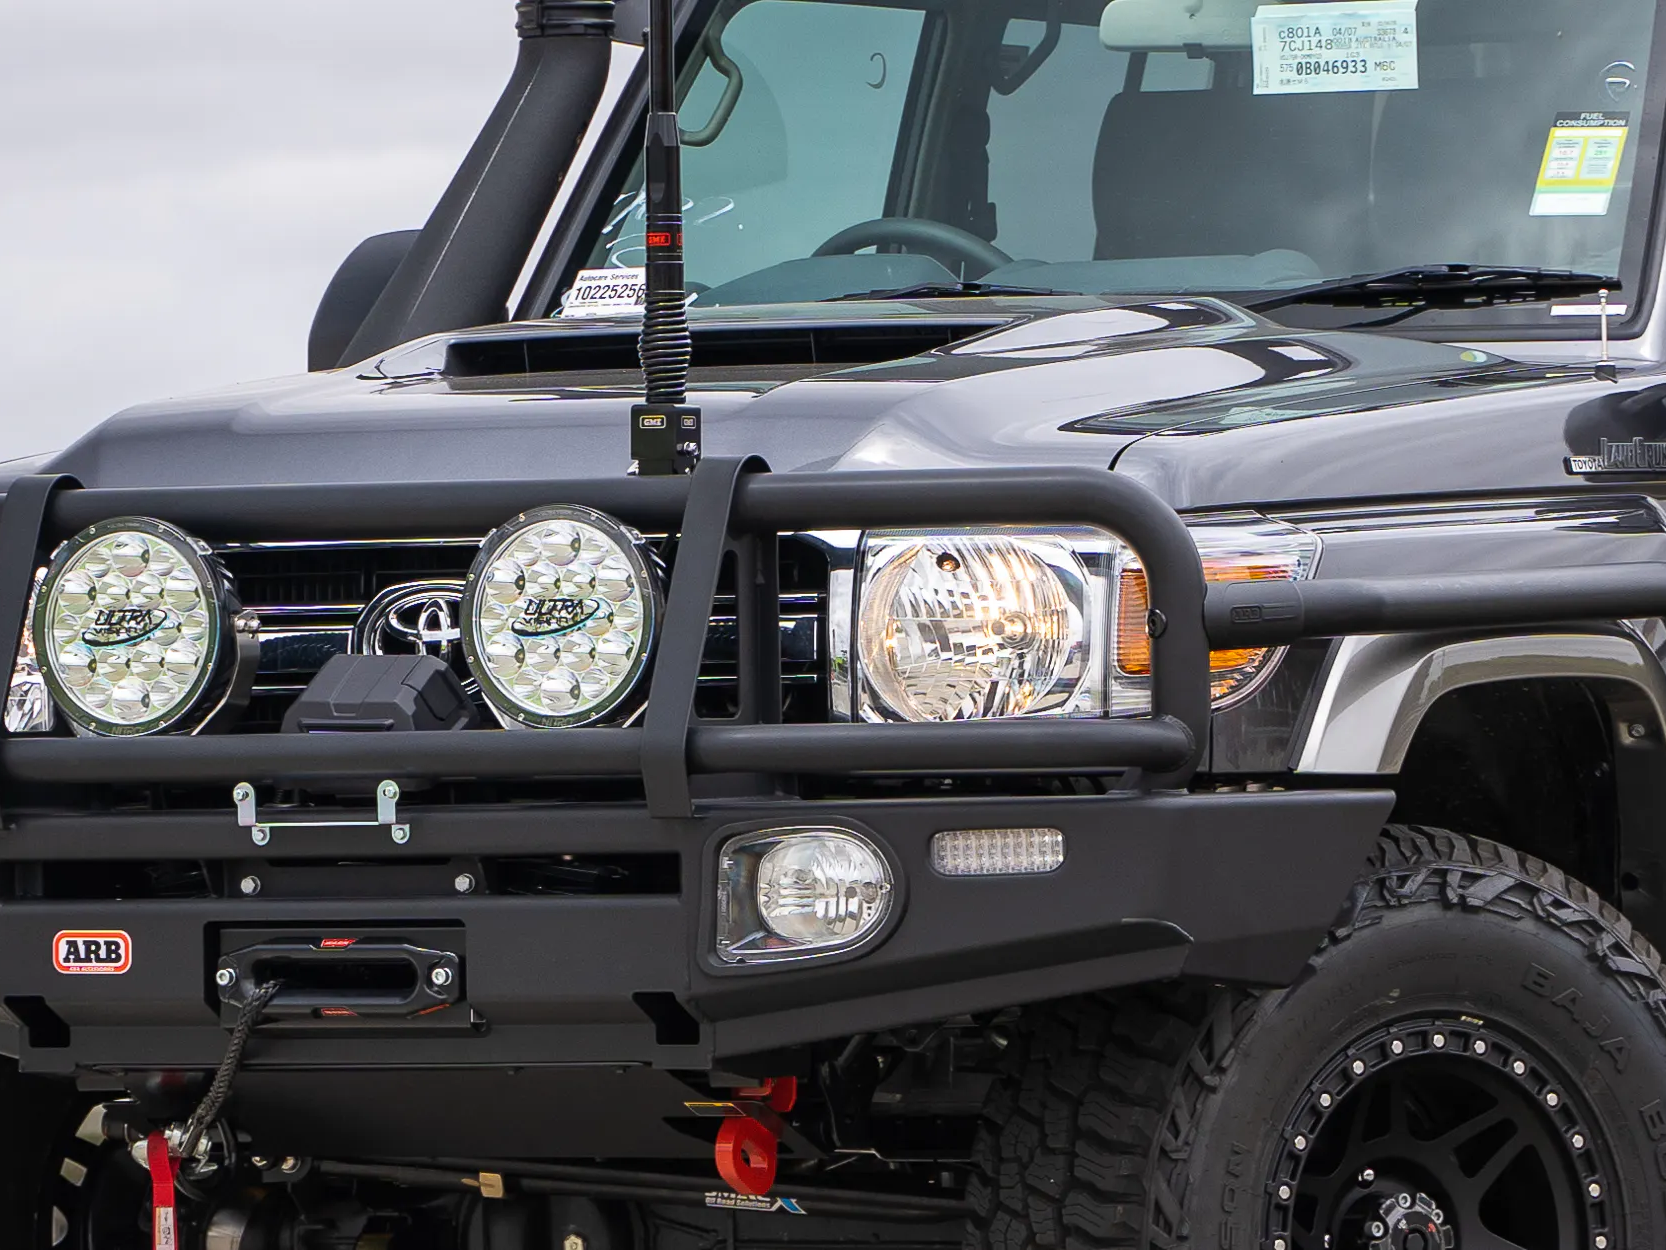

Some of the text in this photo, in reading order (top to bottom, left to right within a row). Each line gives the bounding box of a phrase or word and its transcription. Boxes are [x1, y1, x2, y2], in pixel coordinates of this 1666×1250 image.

[1279, 39, 1333, 52] 7CJ148
[1580, 112, 1605, 120] FUEL
[1556, 119, 1626, 127] CONSUMPTION
[579, 274, 608, 282] Autocare
[575, 283, 646, 301] 10225256
[1572, 458, 1603, 471] TOYOTA
[523, 598, 584, 616] ULTRA
[95, 608, 152, 626] ULTRA
[63, 940, 123, 963] ARB
[1520, 961, 1633, 1076] BAJA
[736, 1199, 771, 1208] Solutions
